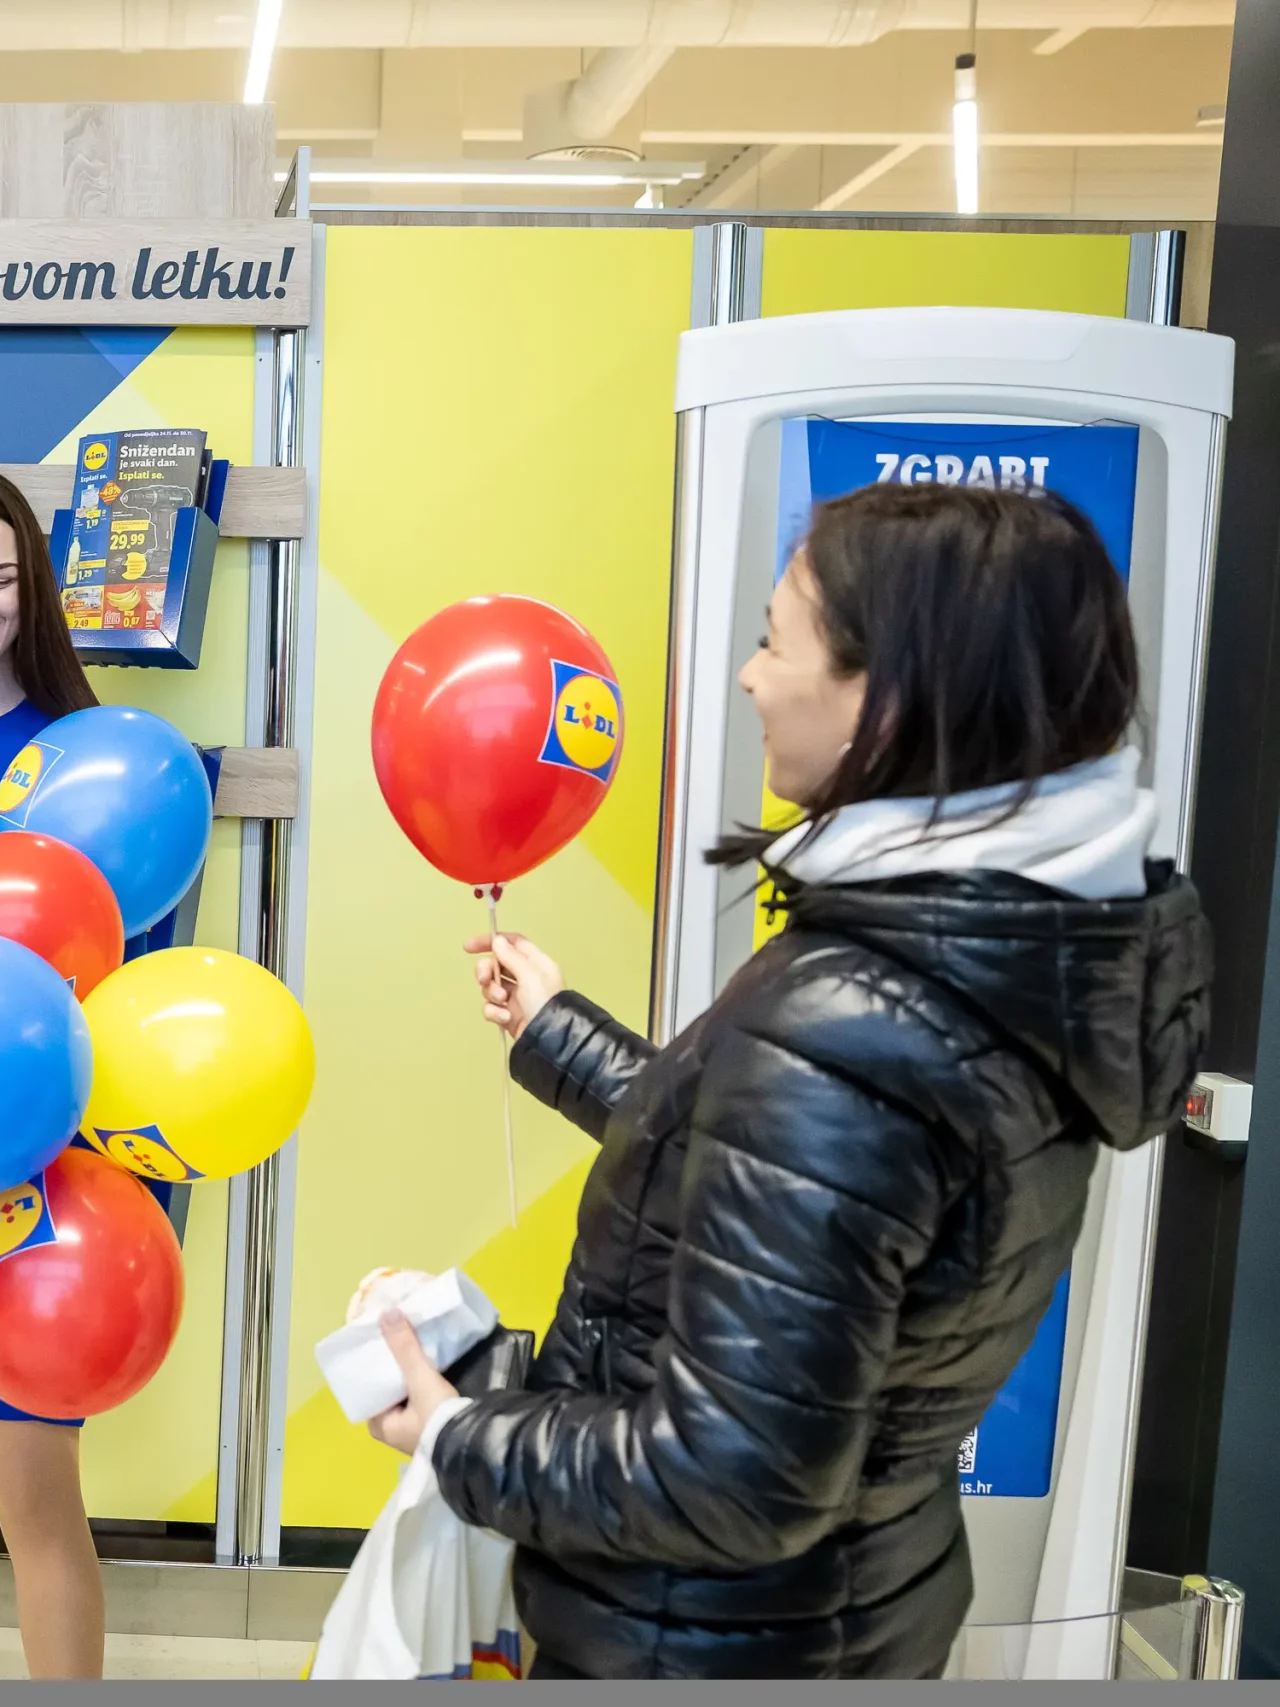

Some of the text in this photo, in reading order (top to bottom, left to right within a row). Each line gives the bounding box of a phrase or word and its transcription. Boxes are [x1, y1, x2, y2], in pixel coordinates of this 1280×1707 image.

[132, 246, 296, 300] letku!
[120, 444, 196, 458] Snižendan
[119, 459, 178, 470] je svaki dan.
[118, 471, 150, 481] Isplati
[110, 534, 145, 550] 29.99
